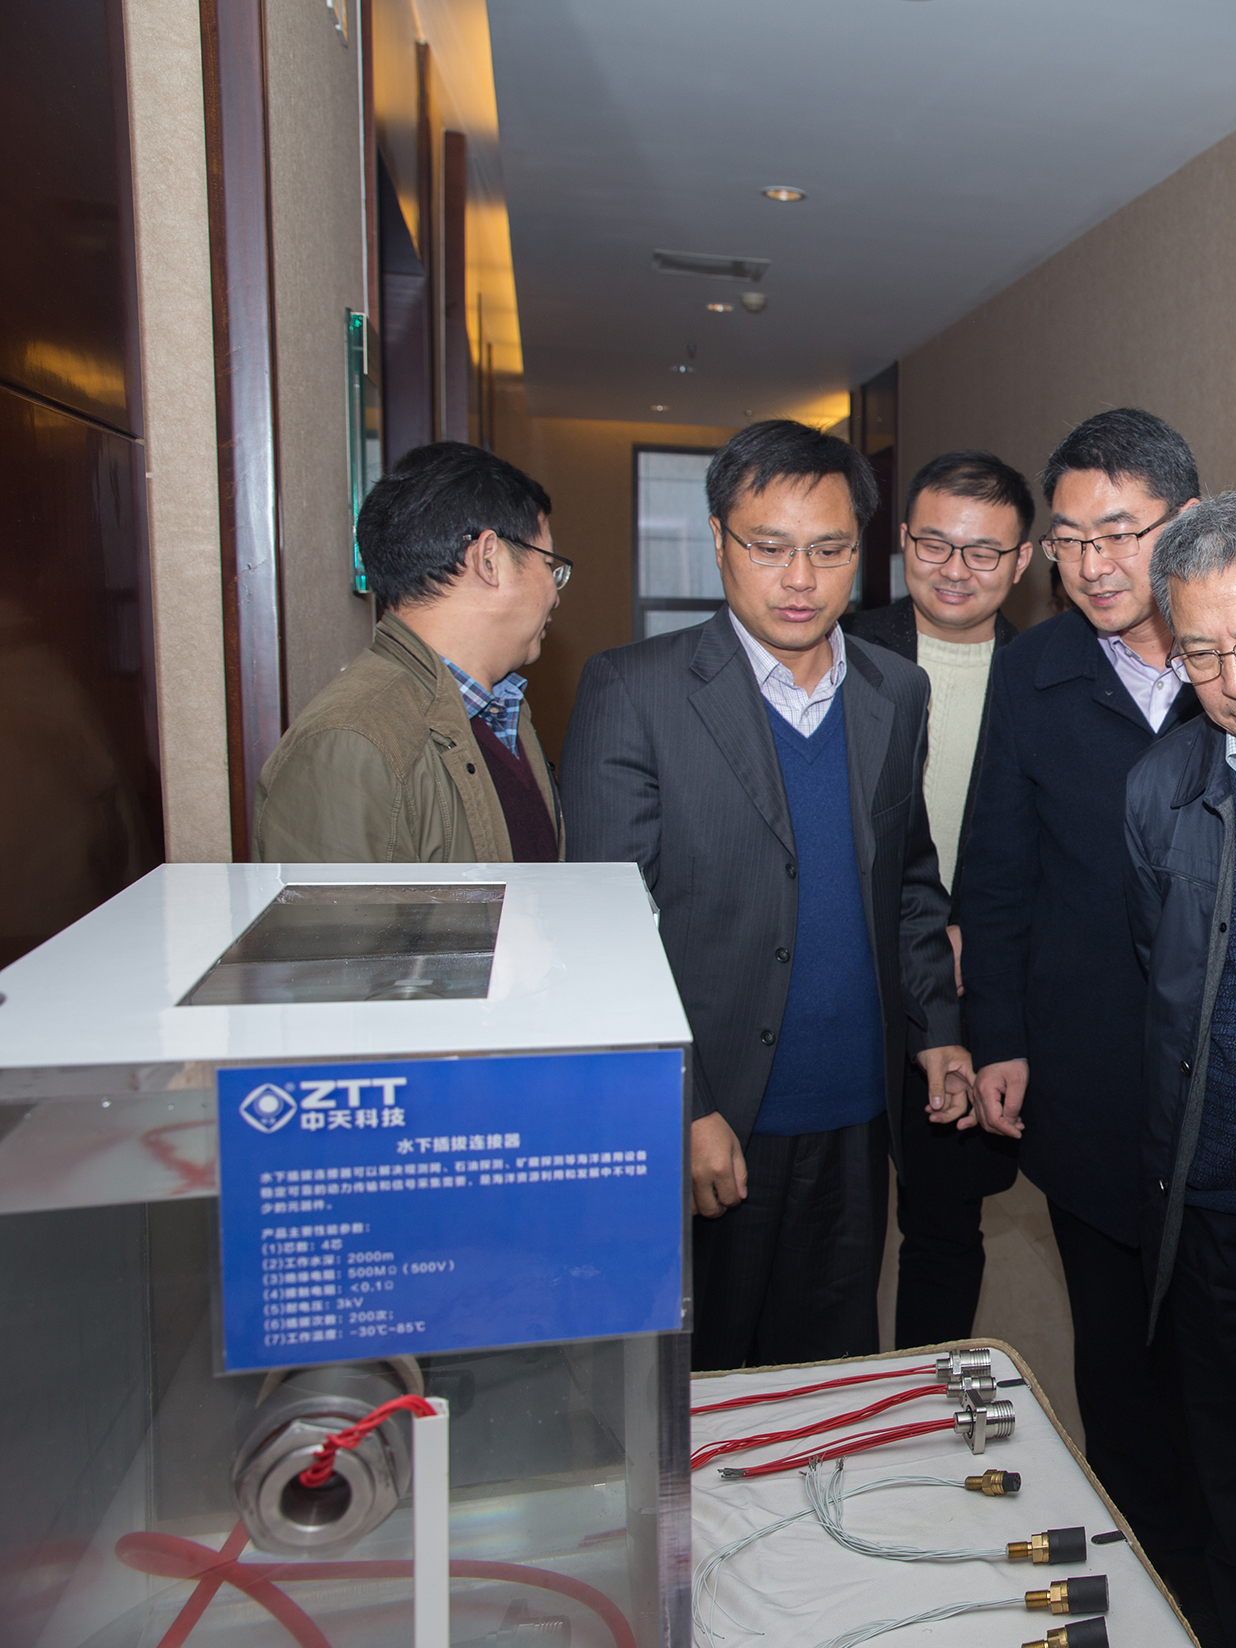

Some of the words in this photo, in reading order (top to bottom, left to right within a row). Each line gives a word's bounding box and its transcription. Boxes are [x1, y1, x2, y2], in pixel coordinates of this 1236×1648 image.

[301, 1077, 407, 1109] ZTT
[301, 1107, 406, 1131] 中天科技
[397, 1133, 520, 1154] 水下插拔连接器
